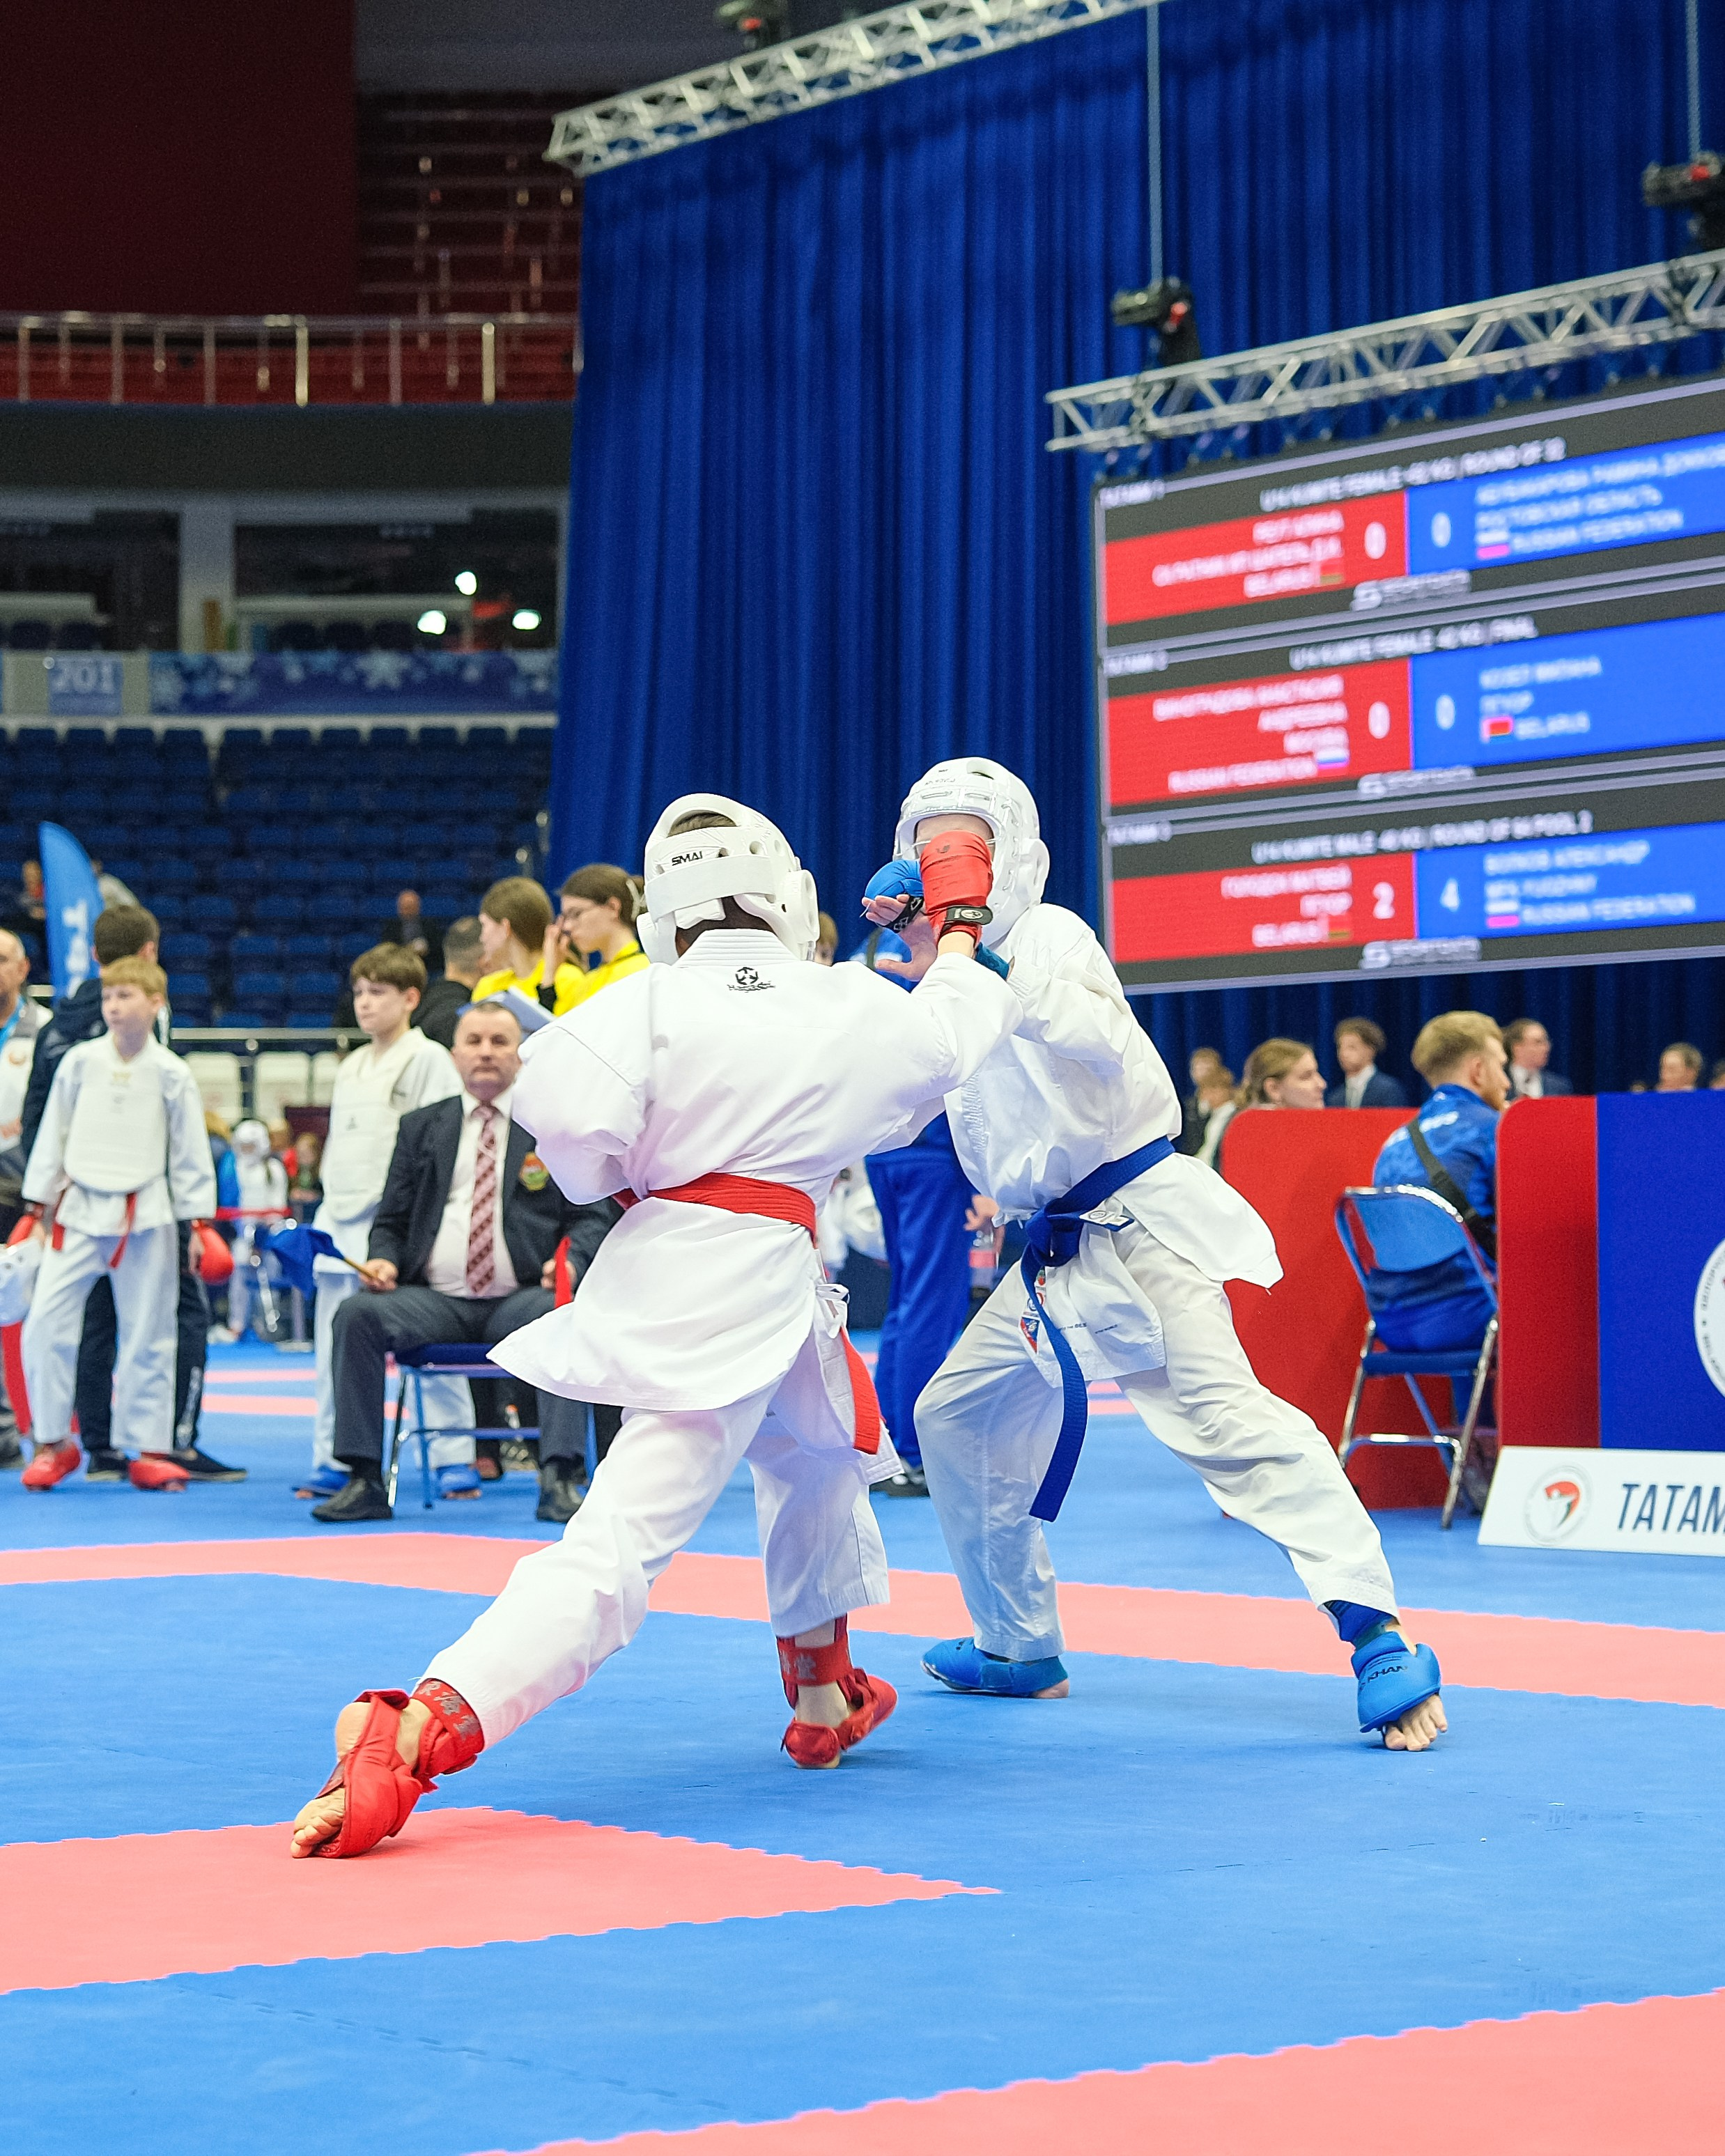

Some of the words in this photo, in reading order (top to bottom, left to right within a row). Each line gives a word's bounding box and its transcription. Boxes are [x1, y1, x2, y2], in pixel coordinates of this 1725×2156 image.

[1364, 521, 1387, 559] 0
[1431, 511, 1451, 548] 0
[1368, 701, 1391, 739] 0
[1435, 694, 1456, 730] 0
[671, 850, 703, 867] SMAI
[1373, 881, 1395, 920] 2
[1439, 877, 1461, 912] 4
